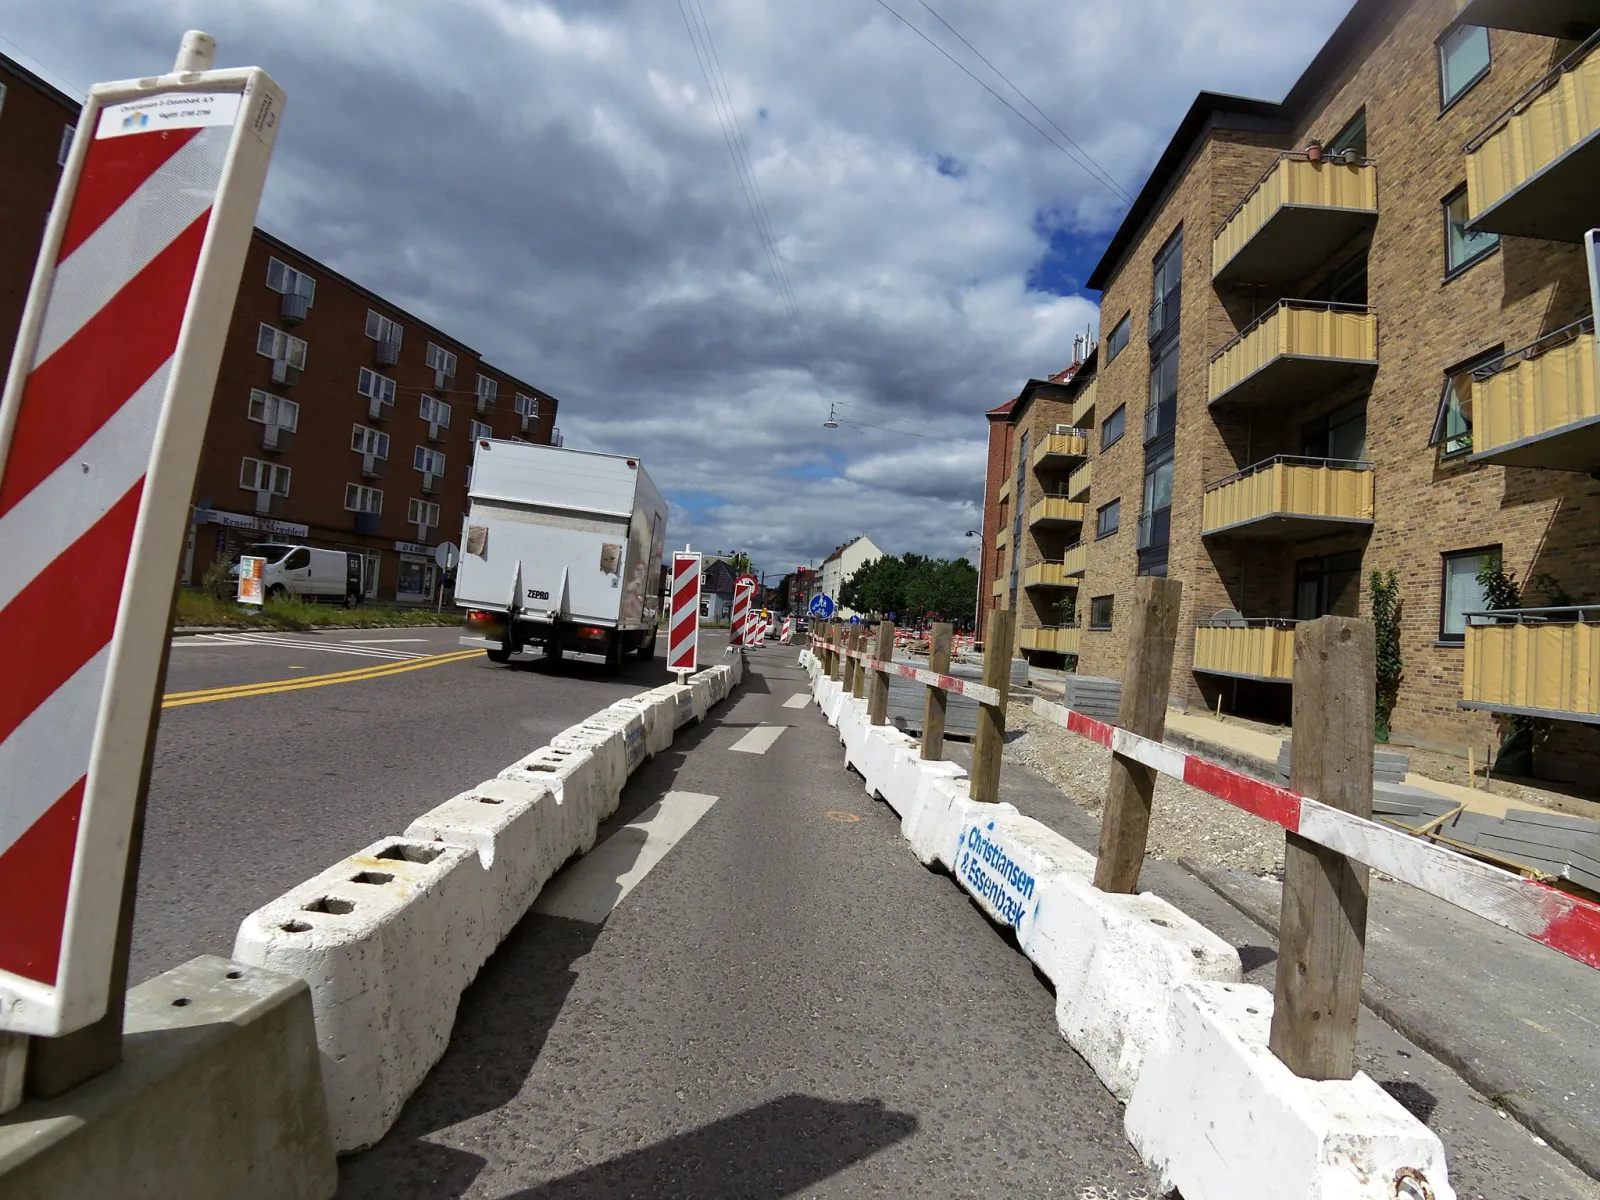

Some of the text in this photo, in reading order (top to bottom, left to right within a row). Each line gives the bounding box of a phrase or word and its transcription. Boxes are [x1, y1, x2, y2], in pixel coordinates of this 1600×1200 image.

[222, 516, 256, 529] Renseri
[266, 524, 305, 536] Skrædderi
[527, 589, 549, 600] ZEPRO
[968, 826, 1035, 900] Christiansen
[961, 852, 1026, 931] & Essenbæk
